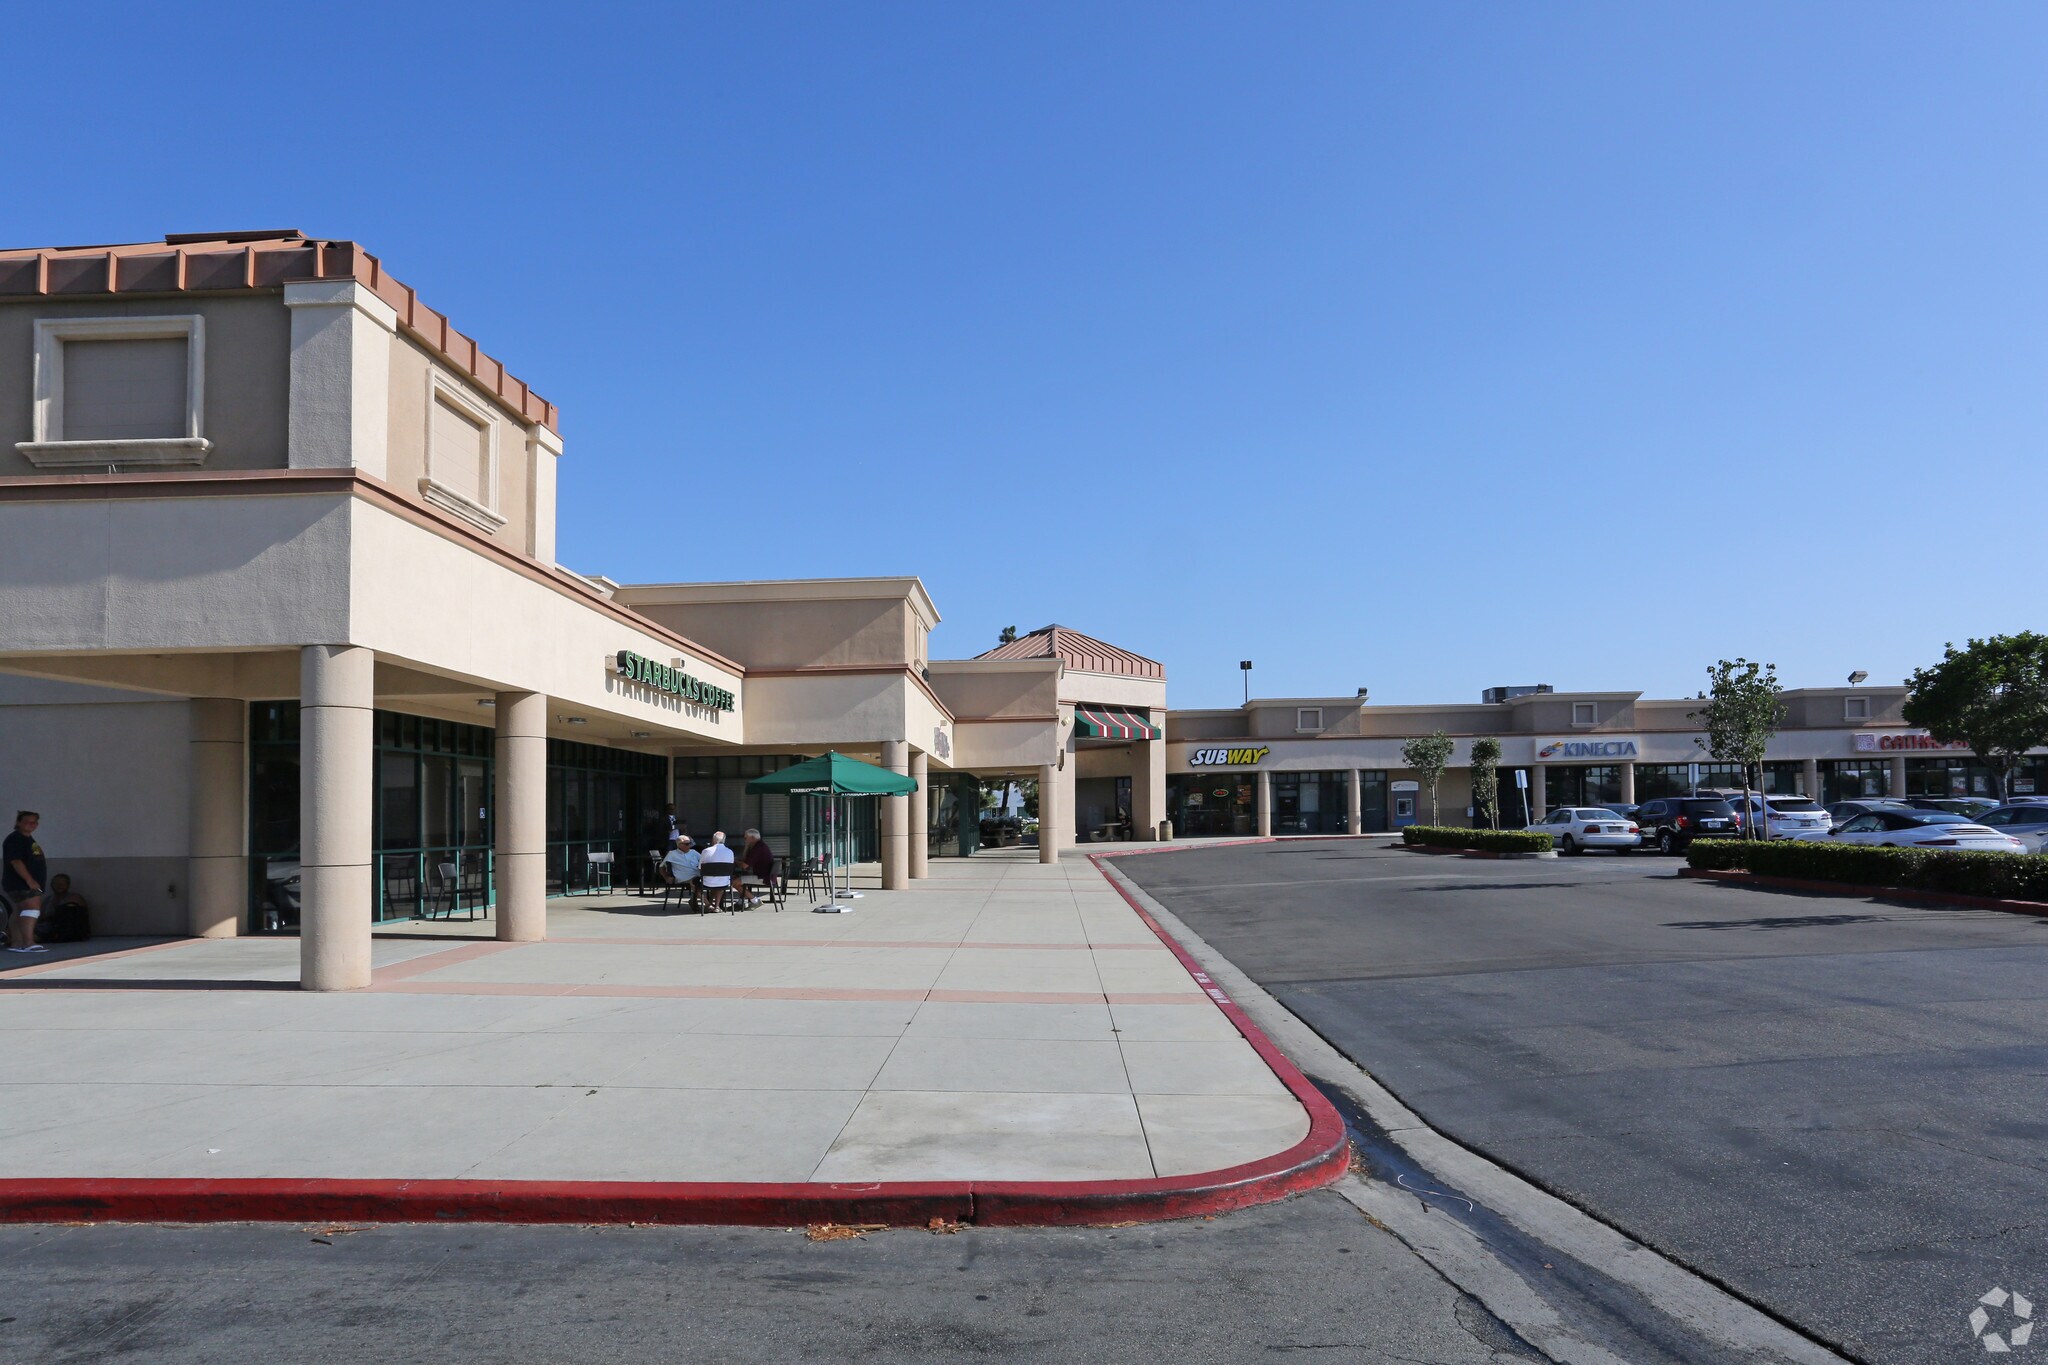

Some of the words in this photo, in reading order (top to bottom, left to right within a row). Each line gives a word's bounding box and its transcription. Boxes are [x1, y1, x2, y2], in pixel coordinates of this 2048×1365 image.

[624, 650, 700, 701] STARBUCKS
[701, 682, 735, 713] COFFEE
[1189, 745, 1270, 768] SUBWAY
[1564, 741, 1638, 757] KINECTA
